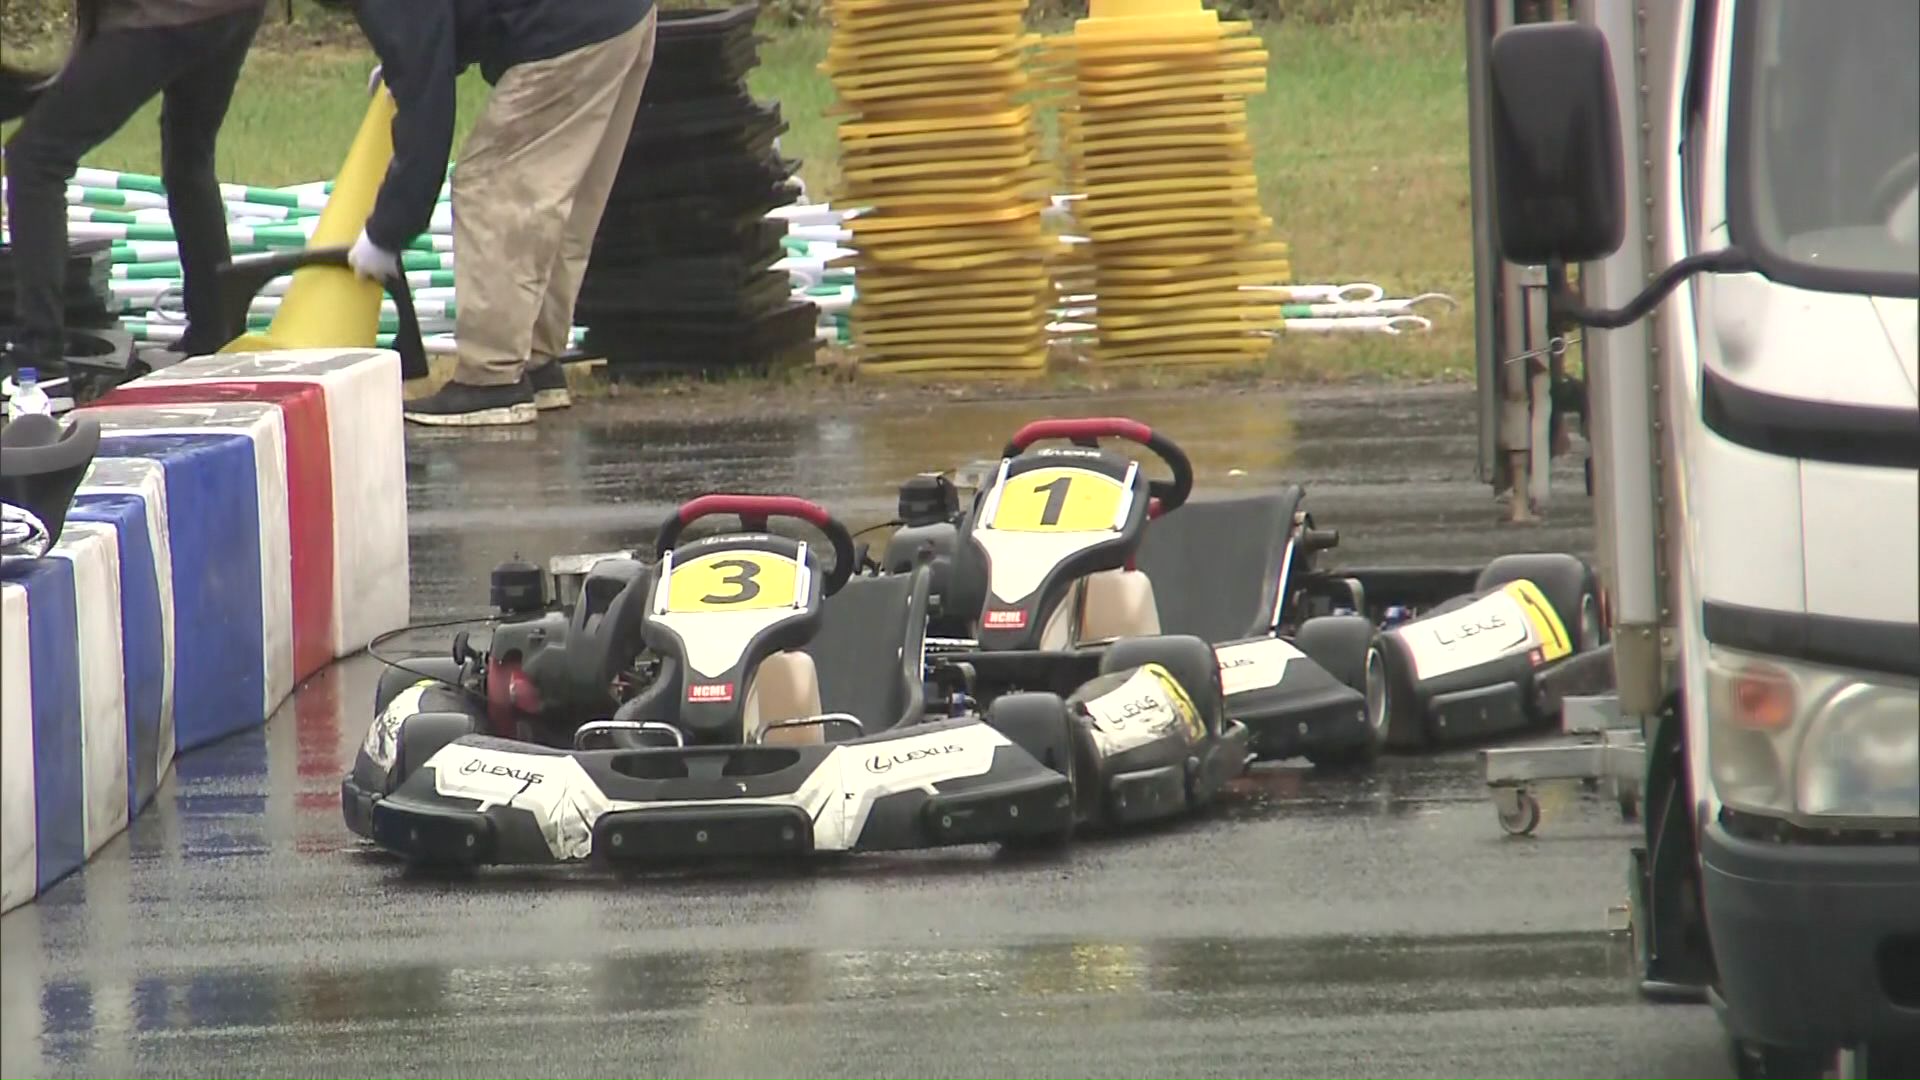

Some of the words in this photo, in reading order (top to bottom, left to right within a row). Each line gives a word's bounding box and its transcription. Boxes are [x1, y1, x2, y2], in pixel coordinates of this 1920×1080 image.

[1033, 477, 1073, 526] 1
[699, 559, 761, 604] 3
[693, 685, 727, 697] NCML
[892, 744, 964, 764] LEXUS
[481, 764, 545, 785] LEXUS
